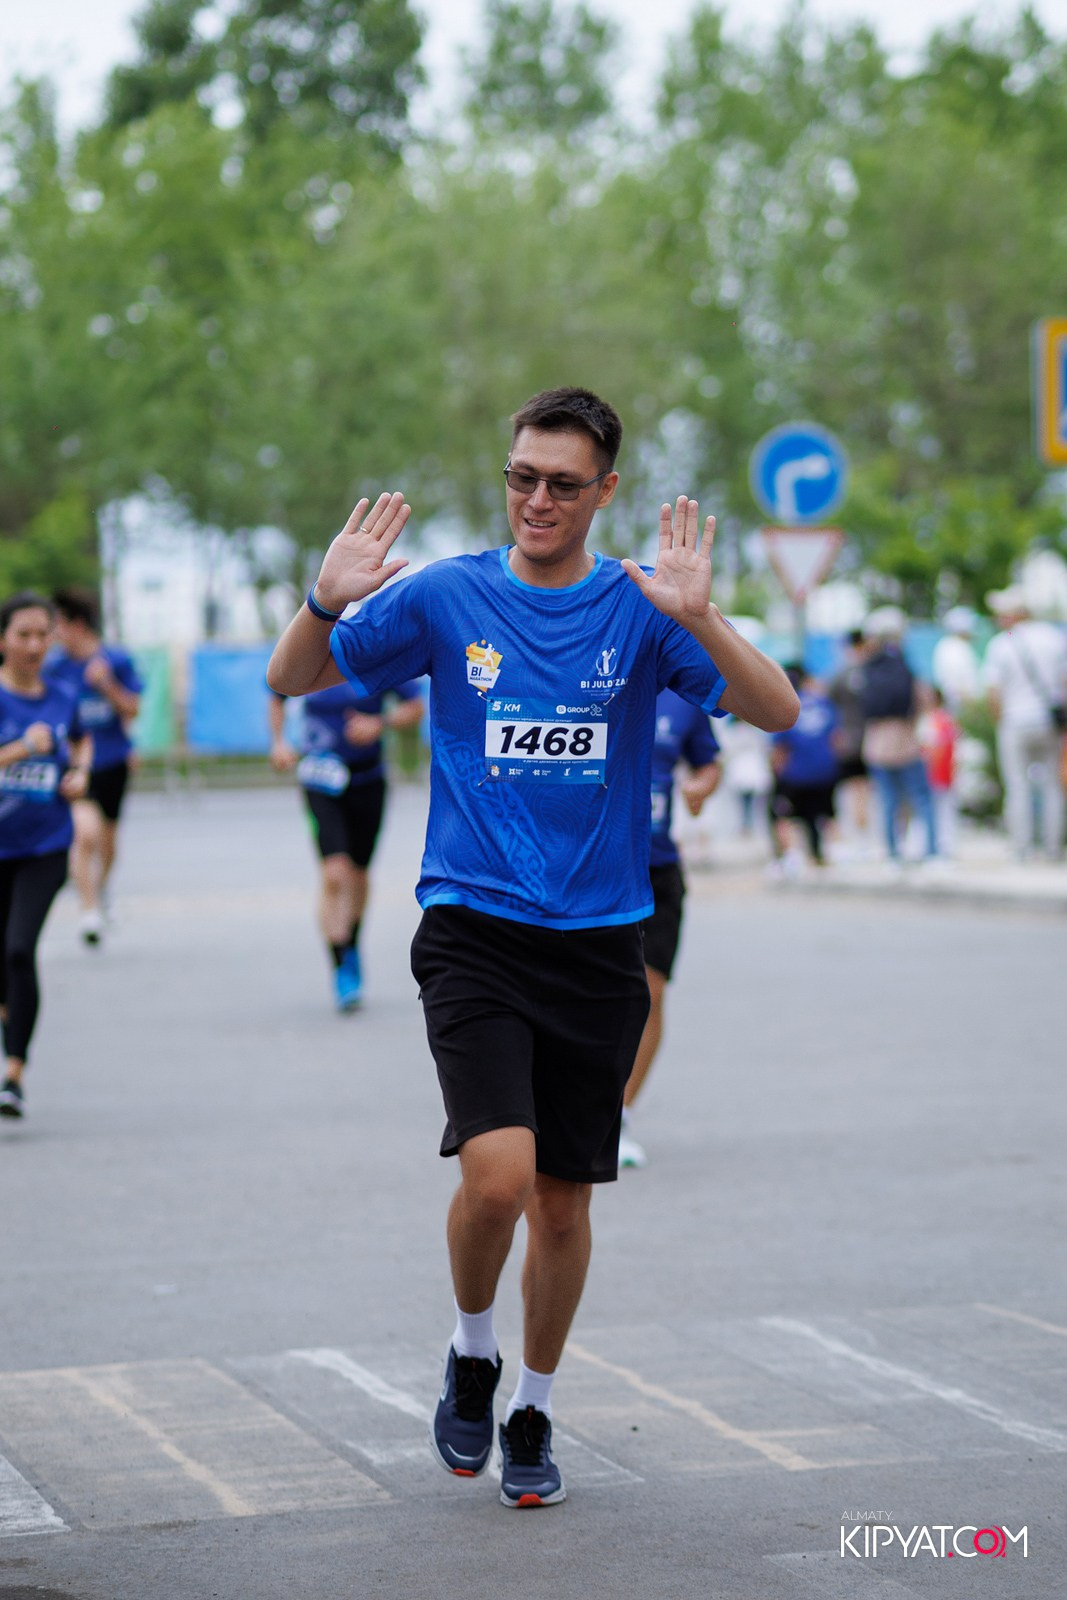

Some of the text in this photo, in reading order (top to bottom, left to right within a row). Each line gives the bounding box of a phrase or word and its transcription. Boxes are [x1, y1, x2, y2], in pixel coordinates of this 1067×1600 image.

[471, 666, 483, 677] BI
[580, 680, 590, 689] BI
[492, 700, 521, 713] 5 KM
[500, 725, 594, 756] 1468
